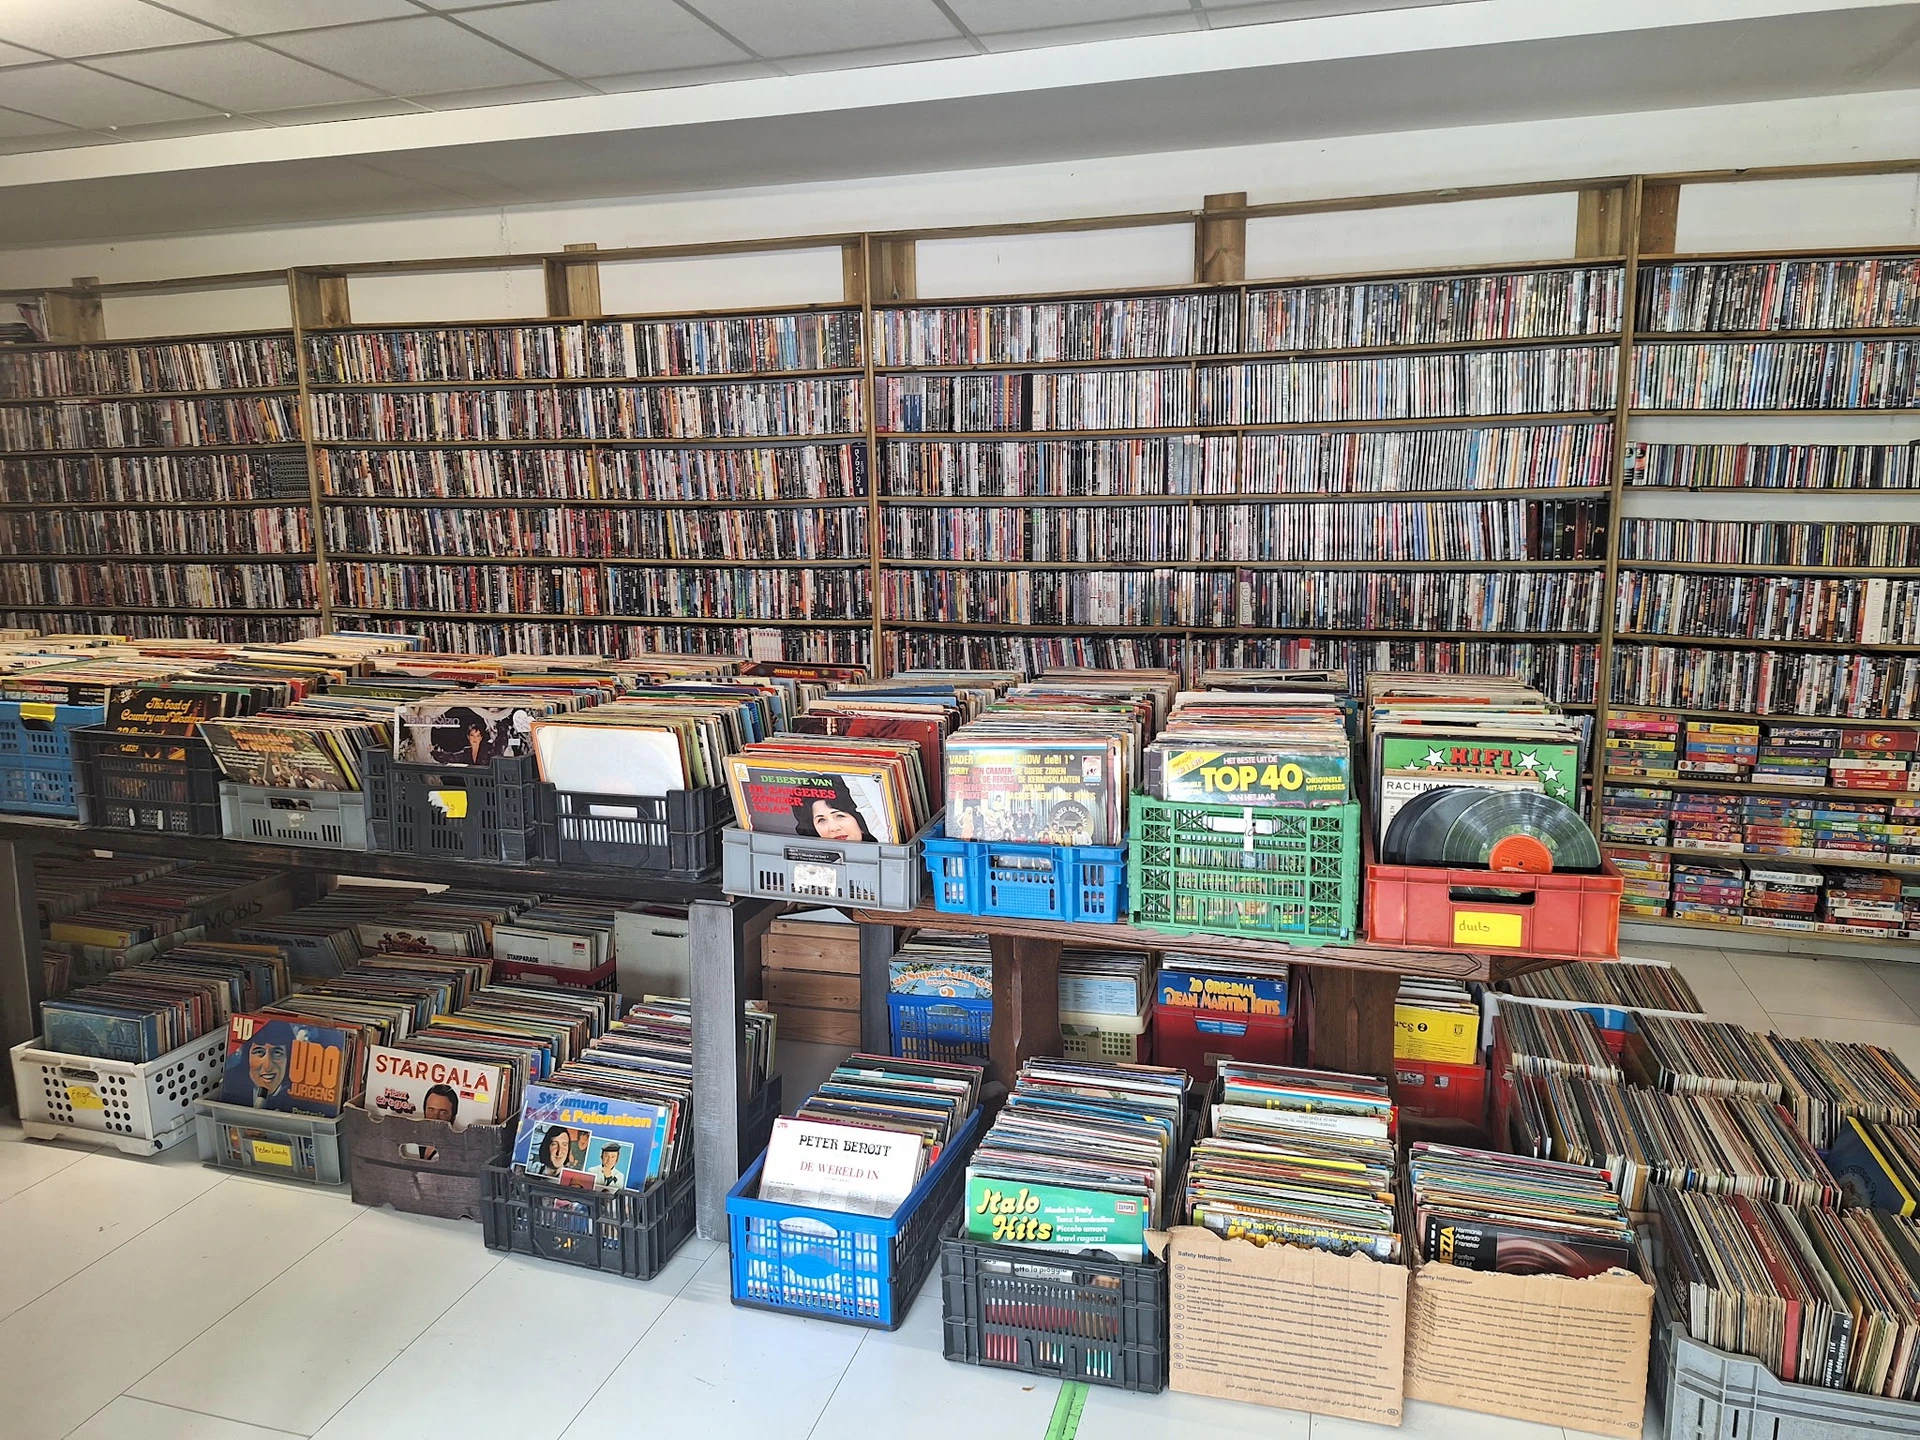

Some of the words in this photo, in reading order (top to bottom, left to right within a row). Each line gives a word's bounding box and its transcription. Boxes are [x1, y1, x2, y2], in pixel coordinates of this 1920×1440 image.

[121, 708, 154, 725] Country
[155, 712, 169, 722] and
[949, 755, 973, 765] VADER
[1018, 755, 1041, 765] SHOW
[1223, 757, 1240, 765] HET
[1240, 756, 1256, 764] BESTE
[1450, 747, 1513, 767] HIFI
[760, 775, 775, 783] DE
[776, 776, 810, 785] BESTE
[811, 778, 833, 787] VAN
[1200, 765, 1258, 793] TOP
[1259, 763, 1304, 792] 40
[1306, 776, 1342, 784] ORIGINELE
[769, 786, 836, 799] ZANGERES
[1228, 794, 1246, 802] VAN
[1257, 793, 1276, 801] JAAR
[507, 953, 540, 964] STARPARADE
[892, 974, 907, 987] 20
[907, 970, 942, 980] Super
[1189, 976, 1203, 993] 20
[1205, 978, 1255, 998] ORIGINAL
[1164, 987, 1199, 1008] DEAN
[1200, 990, 1248, 1013] MARTIN
[1251, 993, 1281, 1015] HITS
[232, 1017, 254, 1041] 40
[289, 1040, 340, 1088] UDO
[573, 1110, 652, 1129] Polonaisen
[798, 1134, 839, 1150] PETER
[800, 1161, 815, 1172] DE
[818, 1163, 864, 1179] WERELD
[867, 1170, 880, 1181] IN
[976, 1187, 1041, 1215] Italo
[992, 1214, 1054, 1241] Hits
[1253, 1222, 1264, 1231] op
[1284, 1225, 1315, 1236] kussen
[1316, 1229, 1329, 1238] stil
[1339, 1232, 1376, 1244] dromen
[1455, 1226, 1483, 1236] Harmonie
[1077, 1235, 1106, 1244] ragazzi
[1178, 1250, 1197, 1259] Safety
[1197, 1253, 1233, 1263] Information
